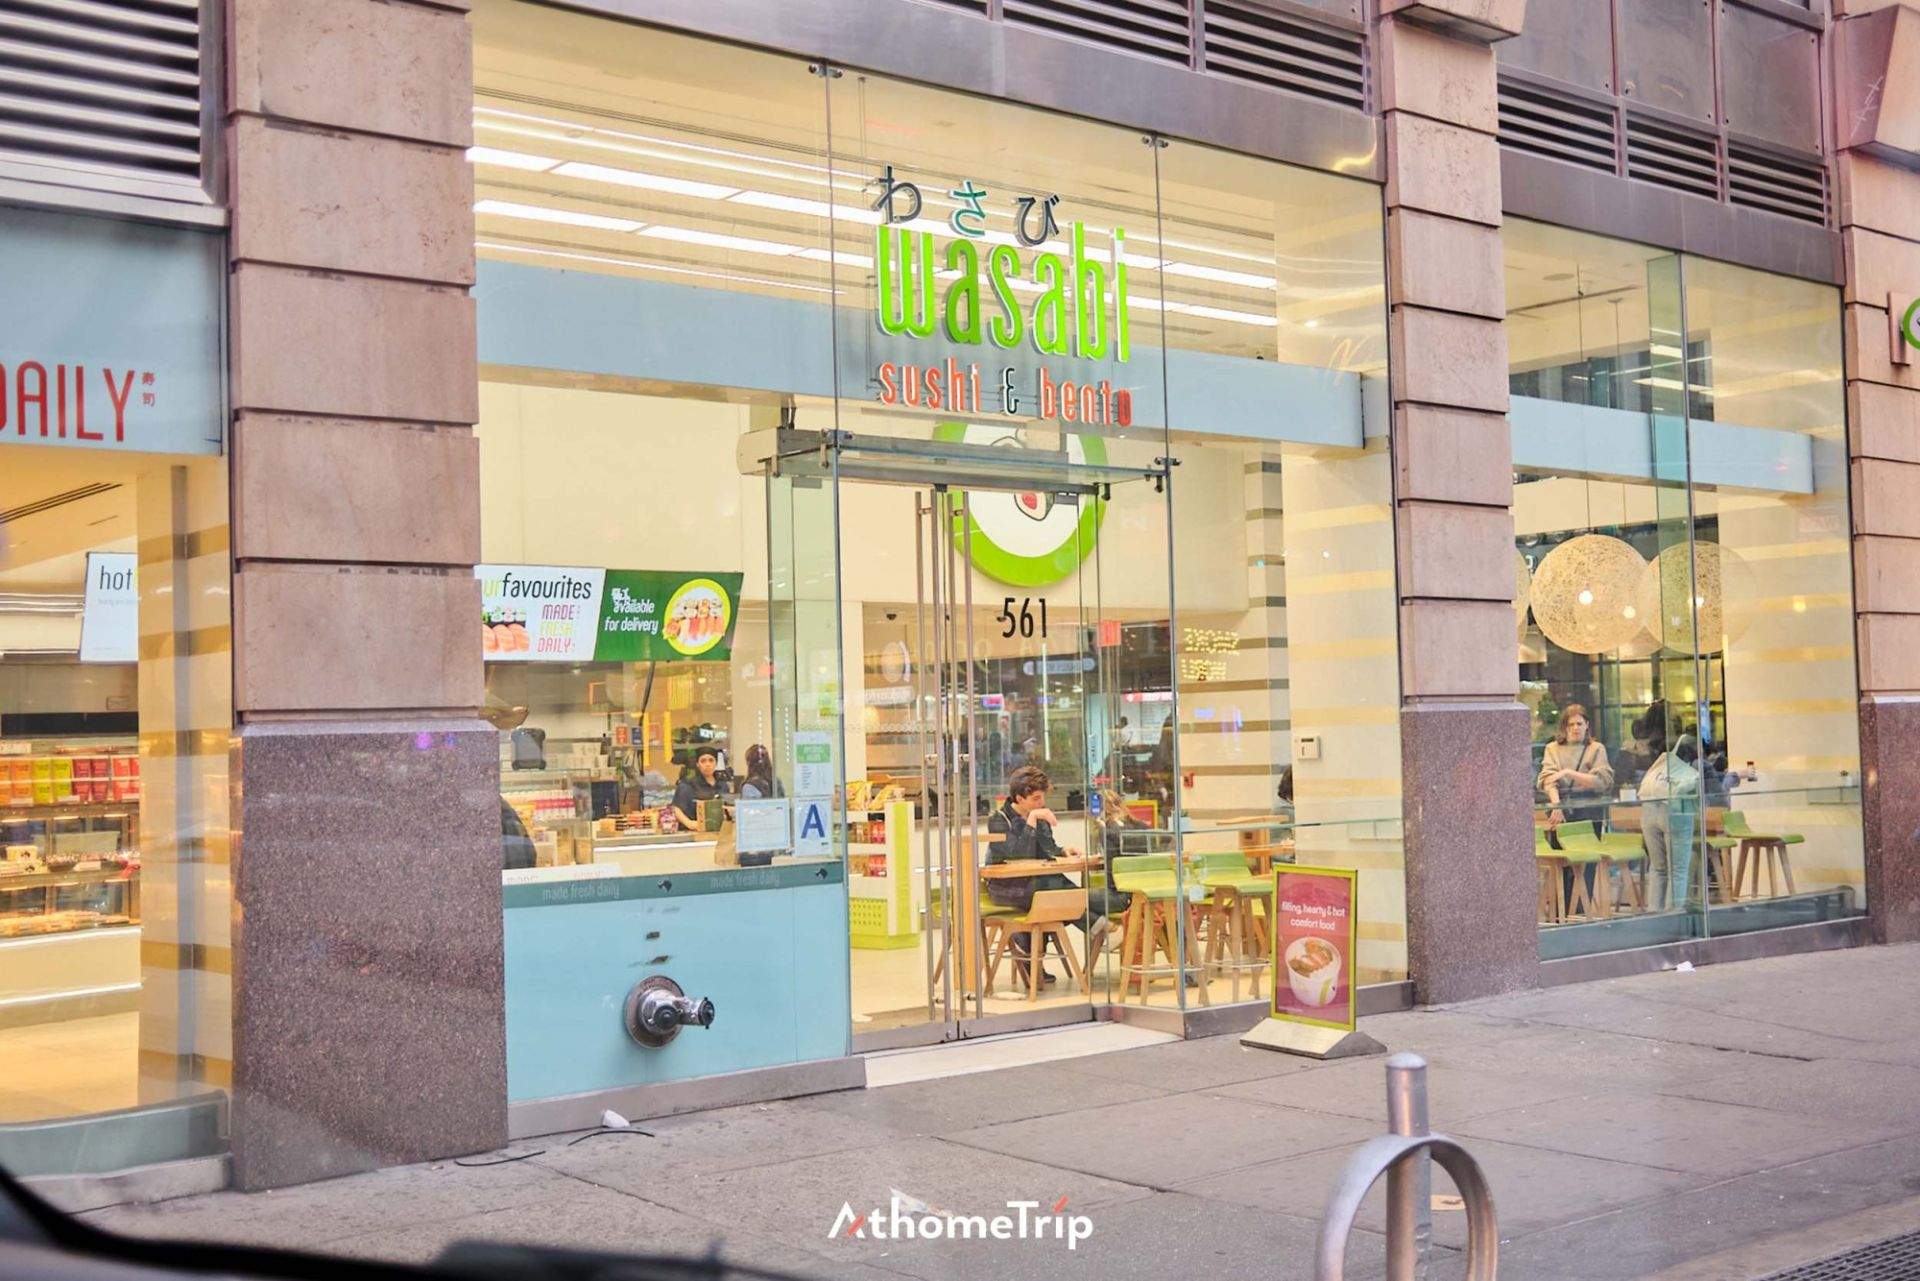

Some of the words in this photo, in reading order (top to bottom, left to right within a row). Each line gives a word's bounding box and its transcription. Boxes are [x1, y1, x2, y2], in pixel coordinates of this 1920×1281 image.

[872, 164, 1060, 246] わさび
[875, 220, 1131, 363] wasabi
[879, 357, 982, 413] sushi
[1001, 366, 1020, 415] &
[1039, 366, 1133, 427] bento
[99, 565, 133, 590] hot
[503, 572, 592, 599] favourites
[613, 599, 655, 613] available
[1002, 597, 1047, 638] 561
[604, 616, 619, 631] for
[621, 616, 659, 635] delivery
[801, 803, 825, 839] A
